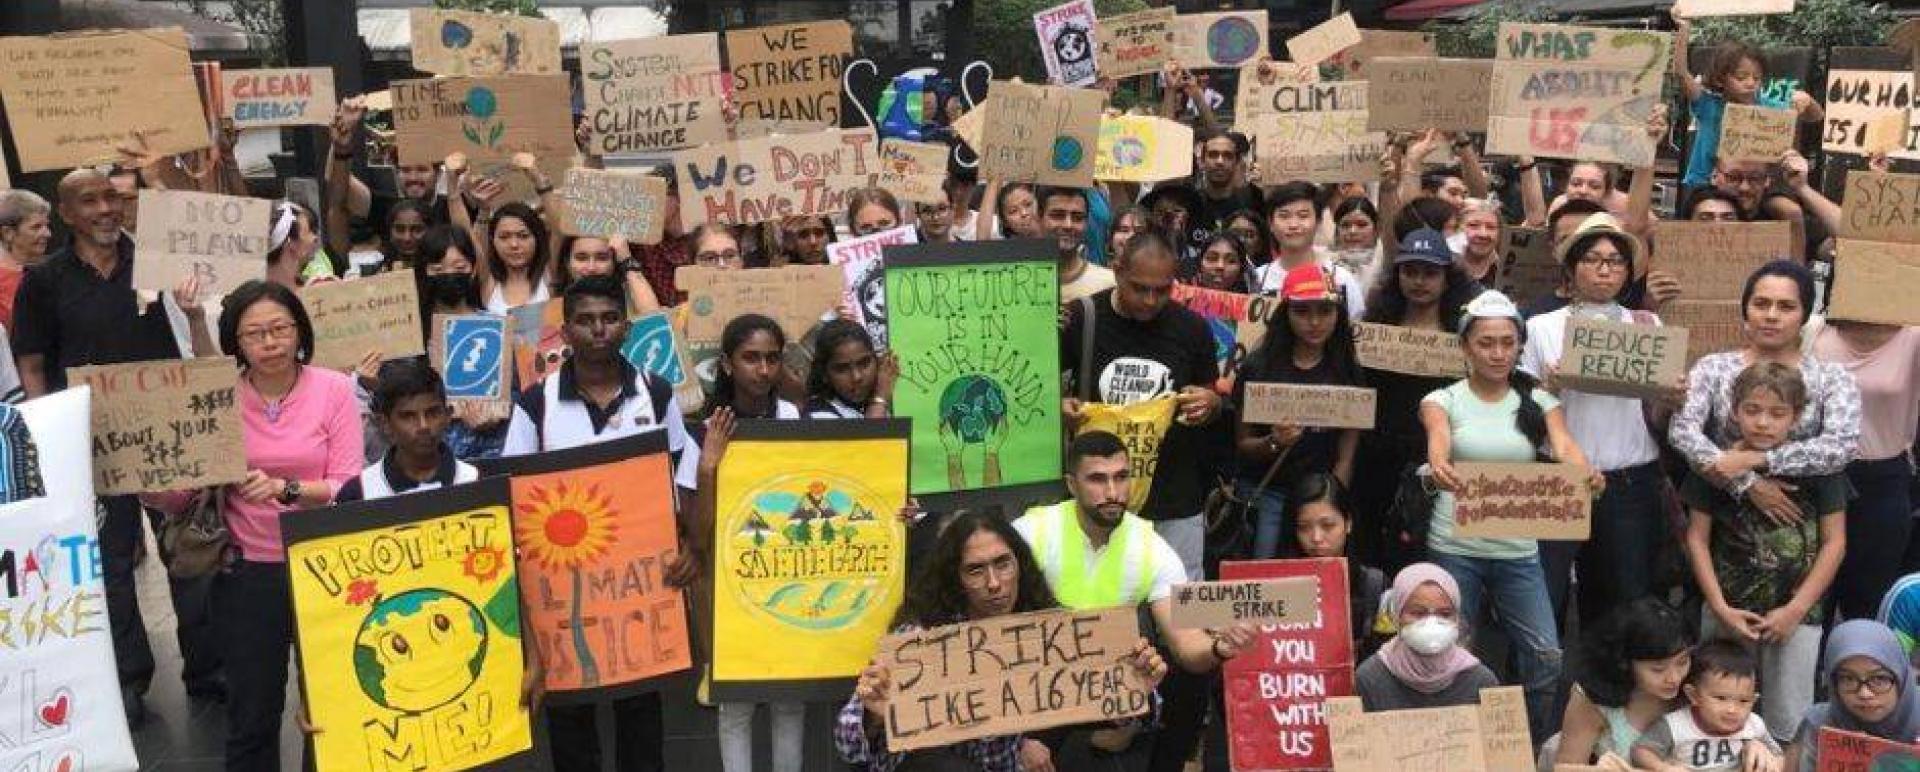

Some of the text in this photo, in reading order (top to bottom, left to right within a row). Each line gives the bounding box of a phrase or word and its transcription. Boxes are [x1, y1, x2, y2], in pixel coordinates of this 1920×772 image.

[762, 28, 808, 51] WE
[1506, 30, 1598, 61] WHAT
[231, 74, 312, 98] CLEAN
[733, 55, 841, 92] STRIKE FO
[392, 83, 447, 102] TIME
[234, 101, 309, 121] ENERGY
[400, 107, 420, 120] TO
[594, 100, 701, 135] CLIMATE
[734, 90, 839, 128] CHANG
[602, 128, 686, 151] CHANGE
[184, 201, 244, 225] NO
[900, 265, 1054, 318] OUR FUTURE
[946, 313, 1008, 341] IS IN
[1573, 327, 1668, 358] REDUCE
[1580, 354, 1660, 386] REUSE
[899, 343, 1045, 426] YOUR HANDS
[304, 513, 497, 597] PROTECT
[1198, 583, 1262, 602] CLIMATE
[1232, 599, 1287, 619] STRIKE
[894, 614, 1106, 691] STRIKE
[1271, 638, 1315, 663] YOU
[1258, 672, 1326, 700] BURN
[888, 664, 1126, 738] LIKE A 16 YEAR
[1101, 689, 1145, 717] OLD
[1269, 703, 1328, 727] WITH
[1279, 730, 1315, 756] US
